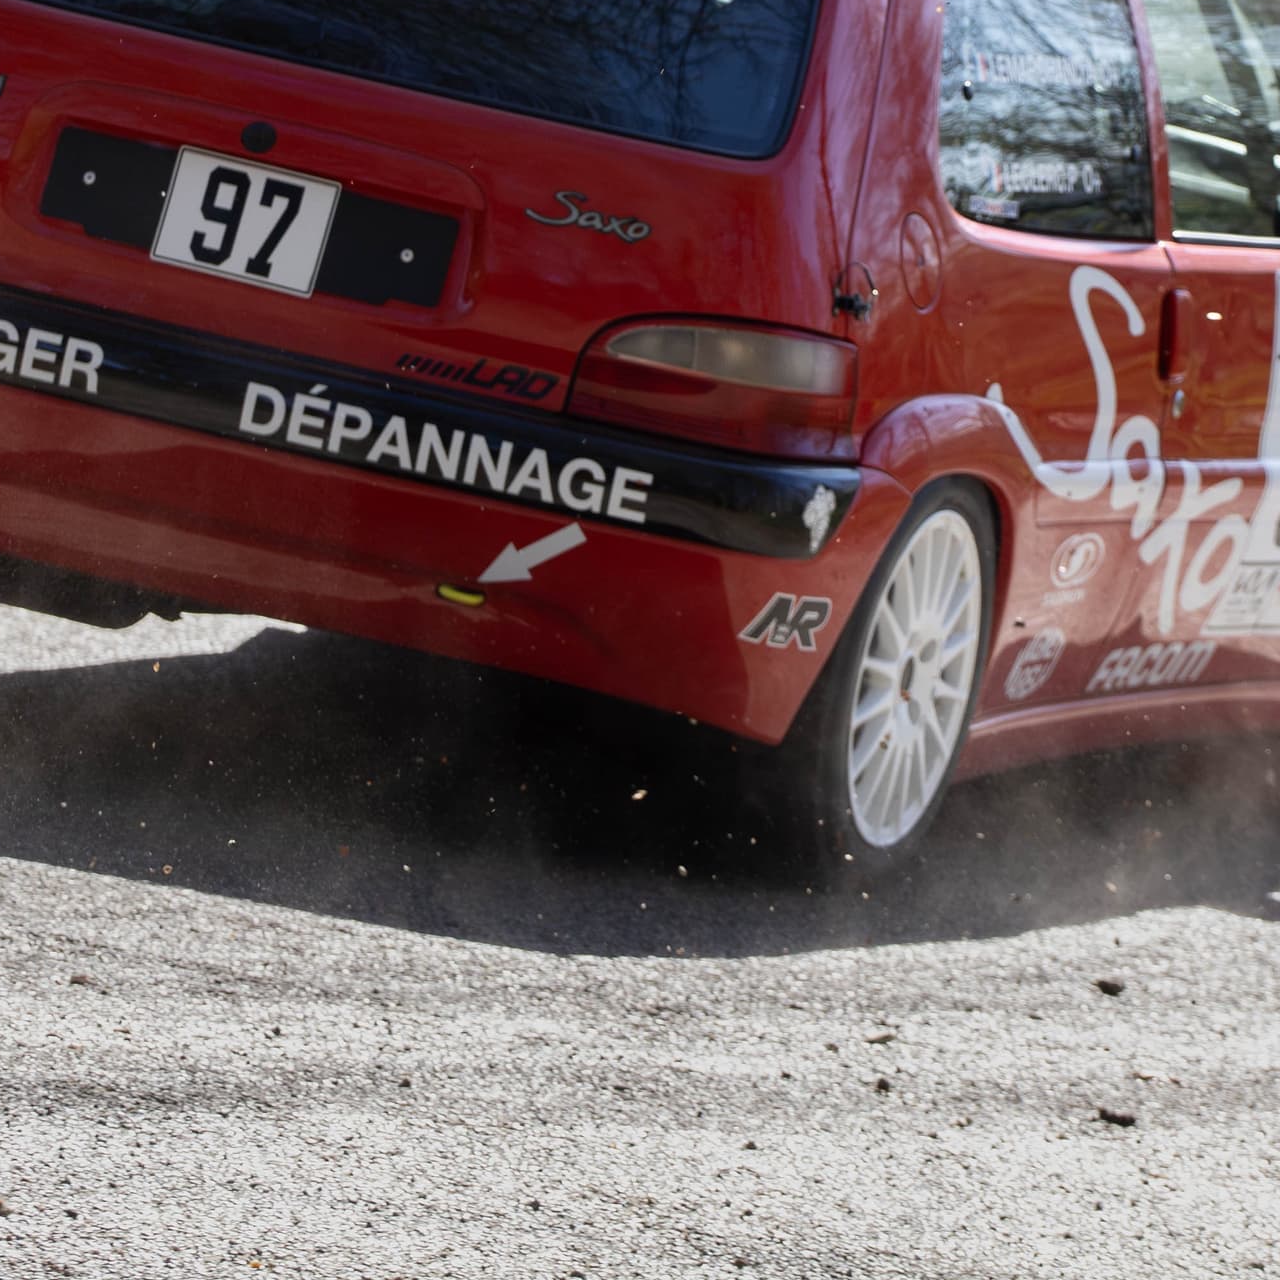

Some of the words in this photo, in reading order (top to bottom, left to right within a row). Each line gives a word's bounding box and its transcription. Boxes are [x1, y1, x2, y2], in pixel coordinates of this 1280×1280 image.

[188, 165, 306, 280] 97
[525, 191, 652, 244] Saxo
[238, 382, 655, 524] DÉPANNAGE
[1085, 640, 1219, 693] FACOM
